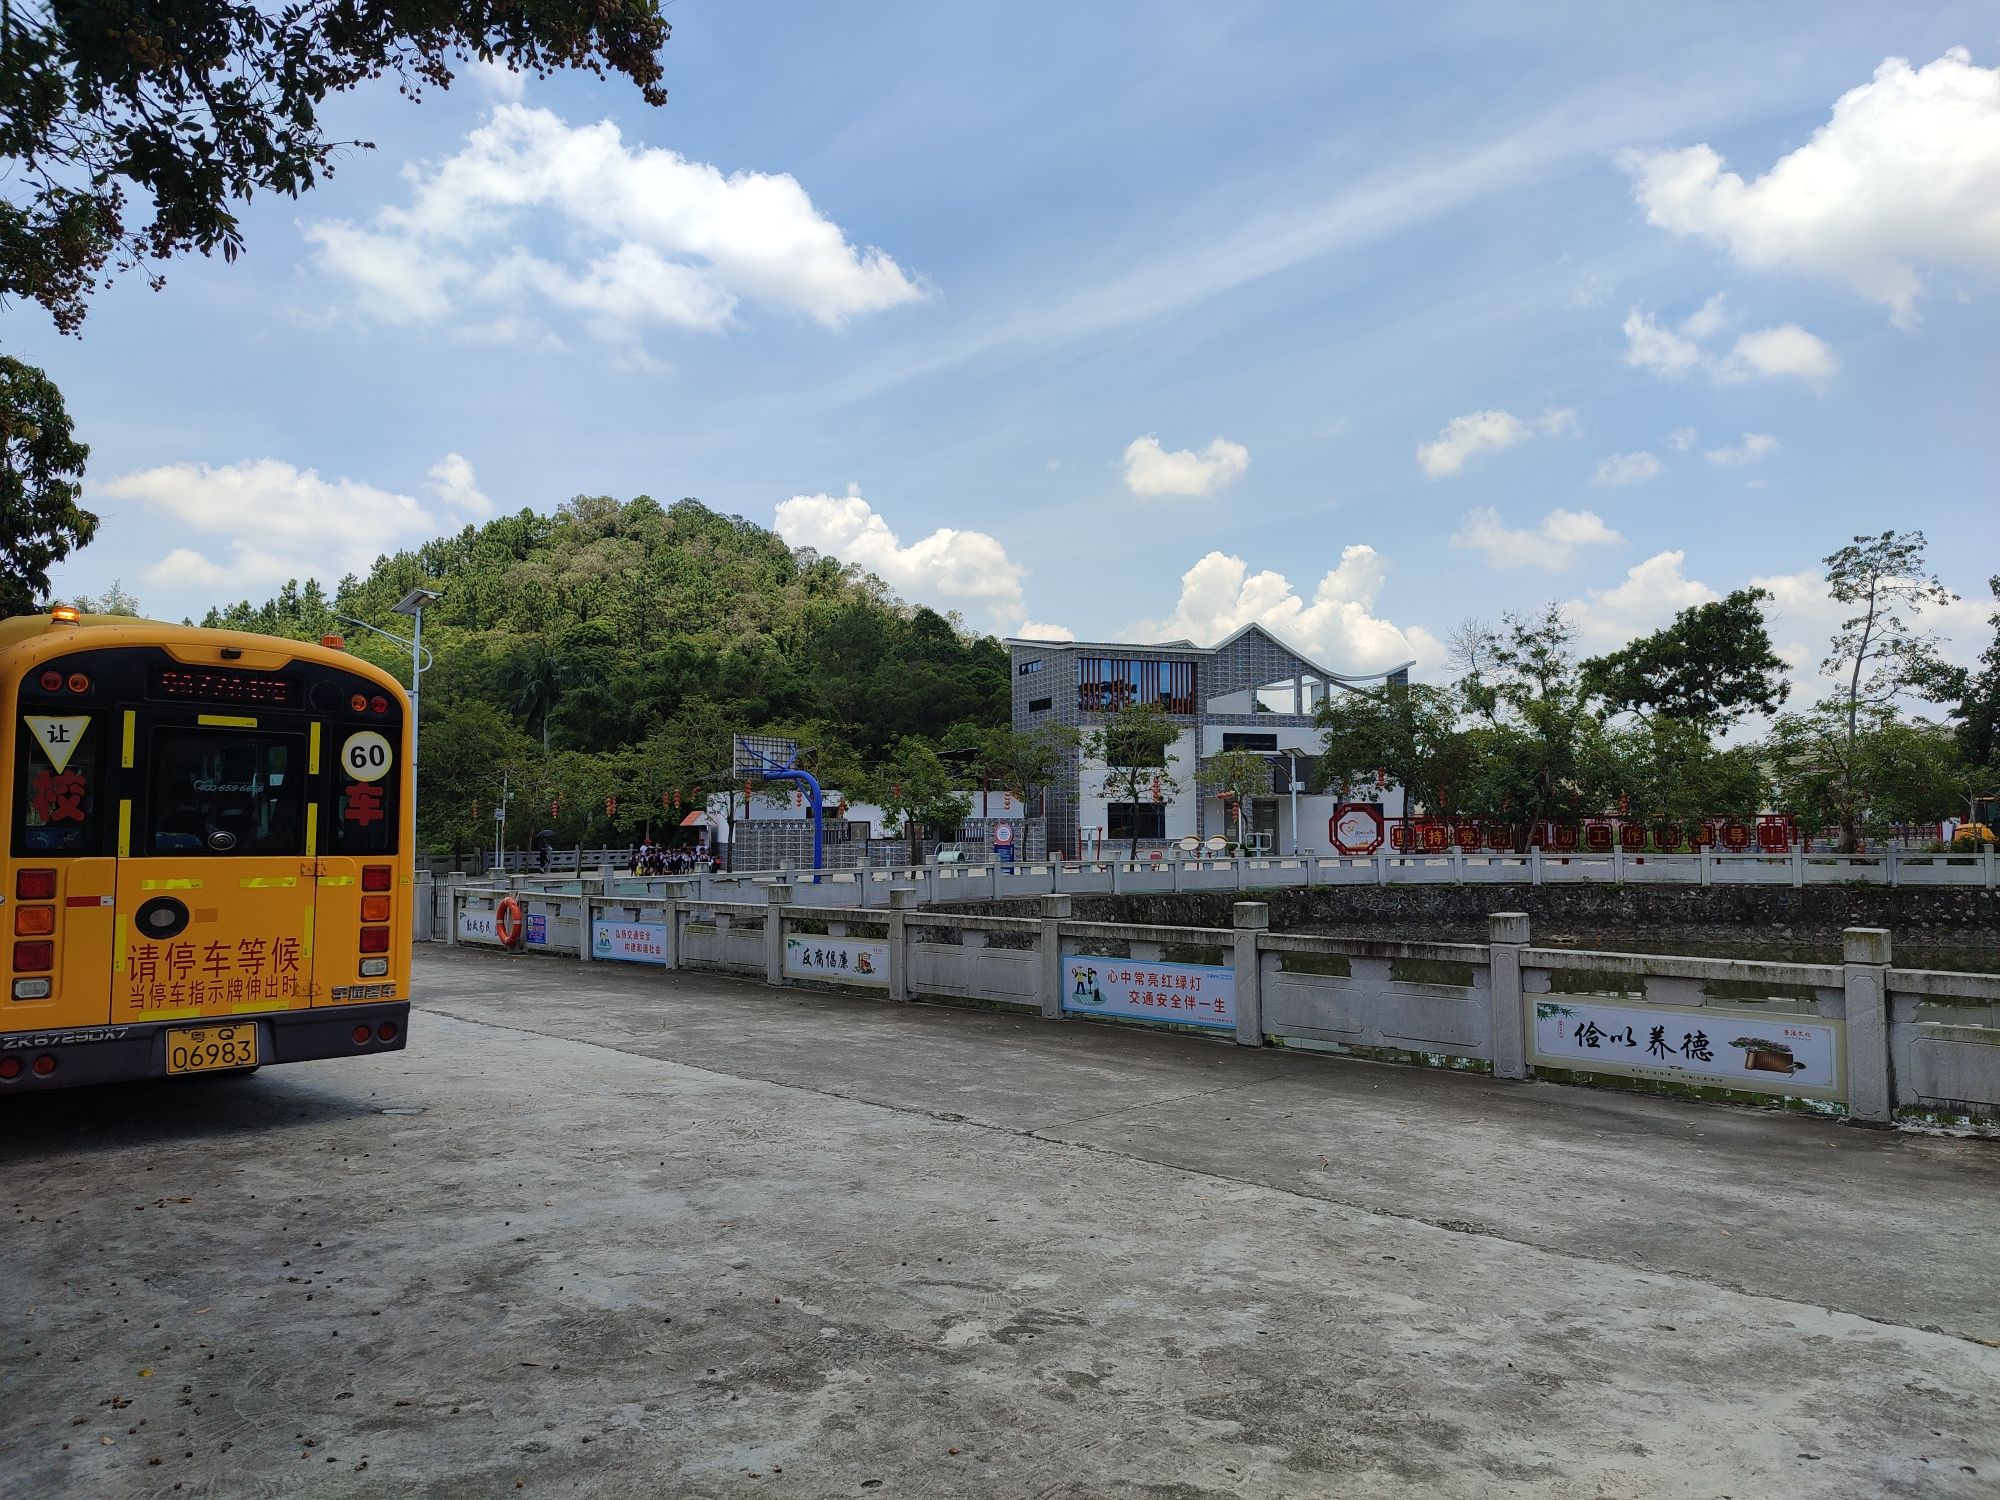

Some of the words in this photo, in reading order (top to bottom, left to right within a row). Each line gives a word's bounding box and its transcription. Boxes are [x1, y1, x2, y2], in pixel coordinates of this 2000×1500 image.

[47, 725, 71, 744] 让
[350, 744, 386, 769] 60
[32, 770, 87, 823] 校
[344, 781, 385, 827] 车
[615, 929, 651, 941] 弘扬交通安全
[128, 936, 301, 984] 请停车等候
[624, 942, 661, 955] 构建和谐社会
[802, 948, 849, 969] 反腐倡廉
[129, 972, 298, 1010] 当停车指示牌伸出时
[331, 983, 399, 1001] 宇通客车
[1107, 969, 1202, 992] 心中常亮红绿灯
[1129, 990, 1227, 1014] 交通安全伴一生
[3, 1027, 129, 1050] ZK6729DX7
[1574, 1021, 1715, 1063] 俭以养德
[172, 1040, 251, 1069] 06983
